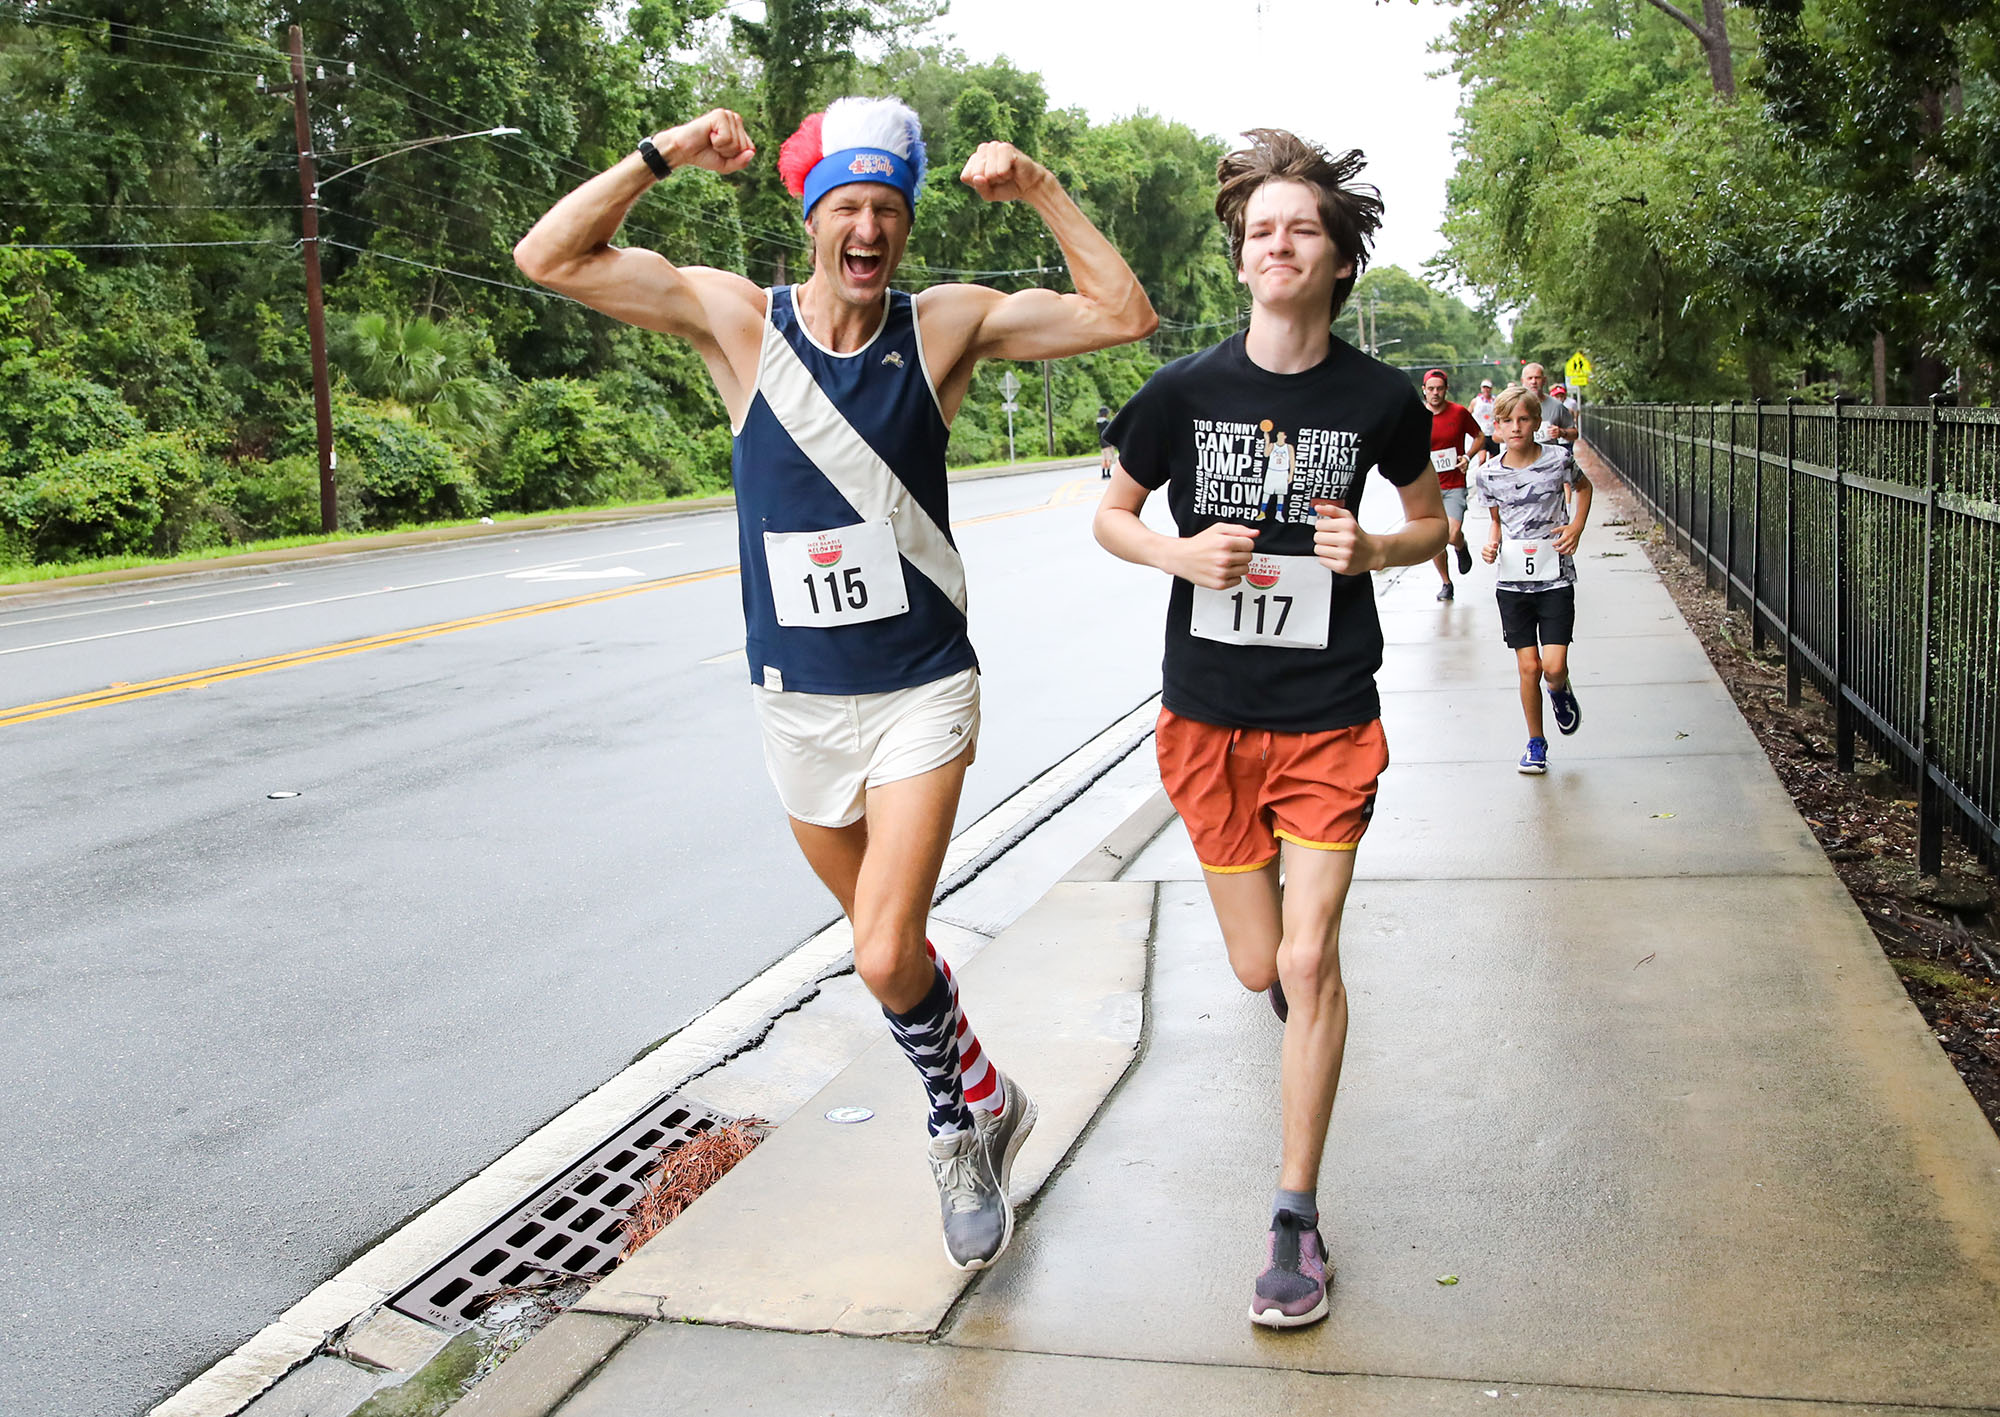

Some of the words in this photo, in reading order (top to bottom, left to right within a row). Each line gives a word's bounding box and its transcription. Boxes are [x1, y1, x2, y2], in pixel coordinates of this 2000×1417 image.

[1193, 419, 1213, 432] TOO
[1215, 421, 1258, 435] SKINNY
[1194, 431, 1255, 455] CAN'T
[1255, 438, 1265, 458] PICK
[1311, 429, 1362, 447] FORTY-
[1196, 449, 1252, 476] JUMP
[1292, 428, 1312, 491] DEFENDER
[1309, 444, 1359, 465] FIRST
[1436, 458, 1451, 469] 120
[1252, 459, 1263, 478] LOW
[1324, 463, 1357, 471] ATTITUDE
[1239, 476, 1263, 484] DENVER
[1304, 469, 1316, 500] ALL-STAR
[1193, 470, 1204, 514] FLAILING
[1208, 480, 1262, 506] SLOW
[1288, 494, 1304, 523] POOR
[1302, 502, 1310, 511] AN
[1299, 510, 1308, 524] NOT
[1526, 557, 1535, 576] 5
[803, 567, 868, 614] 115
[1231, 591, 1293, 636] 117
